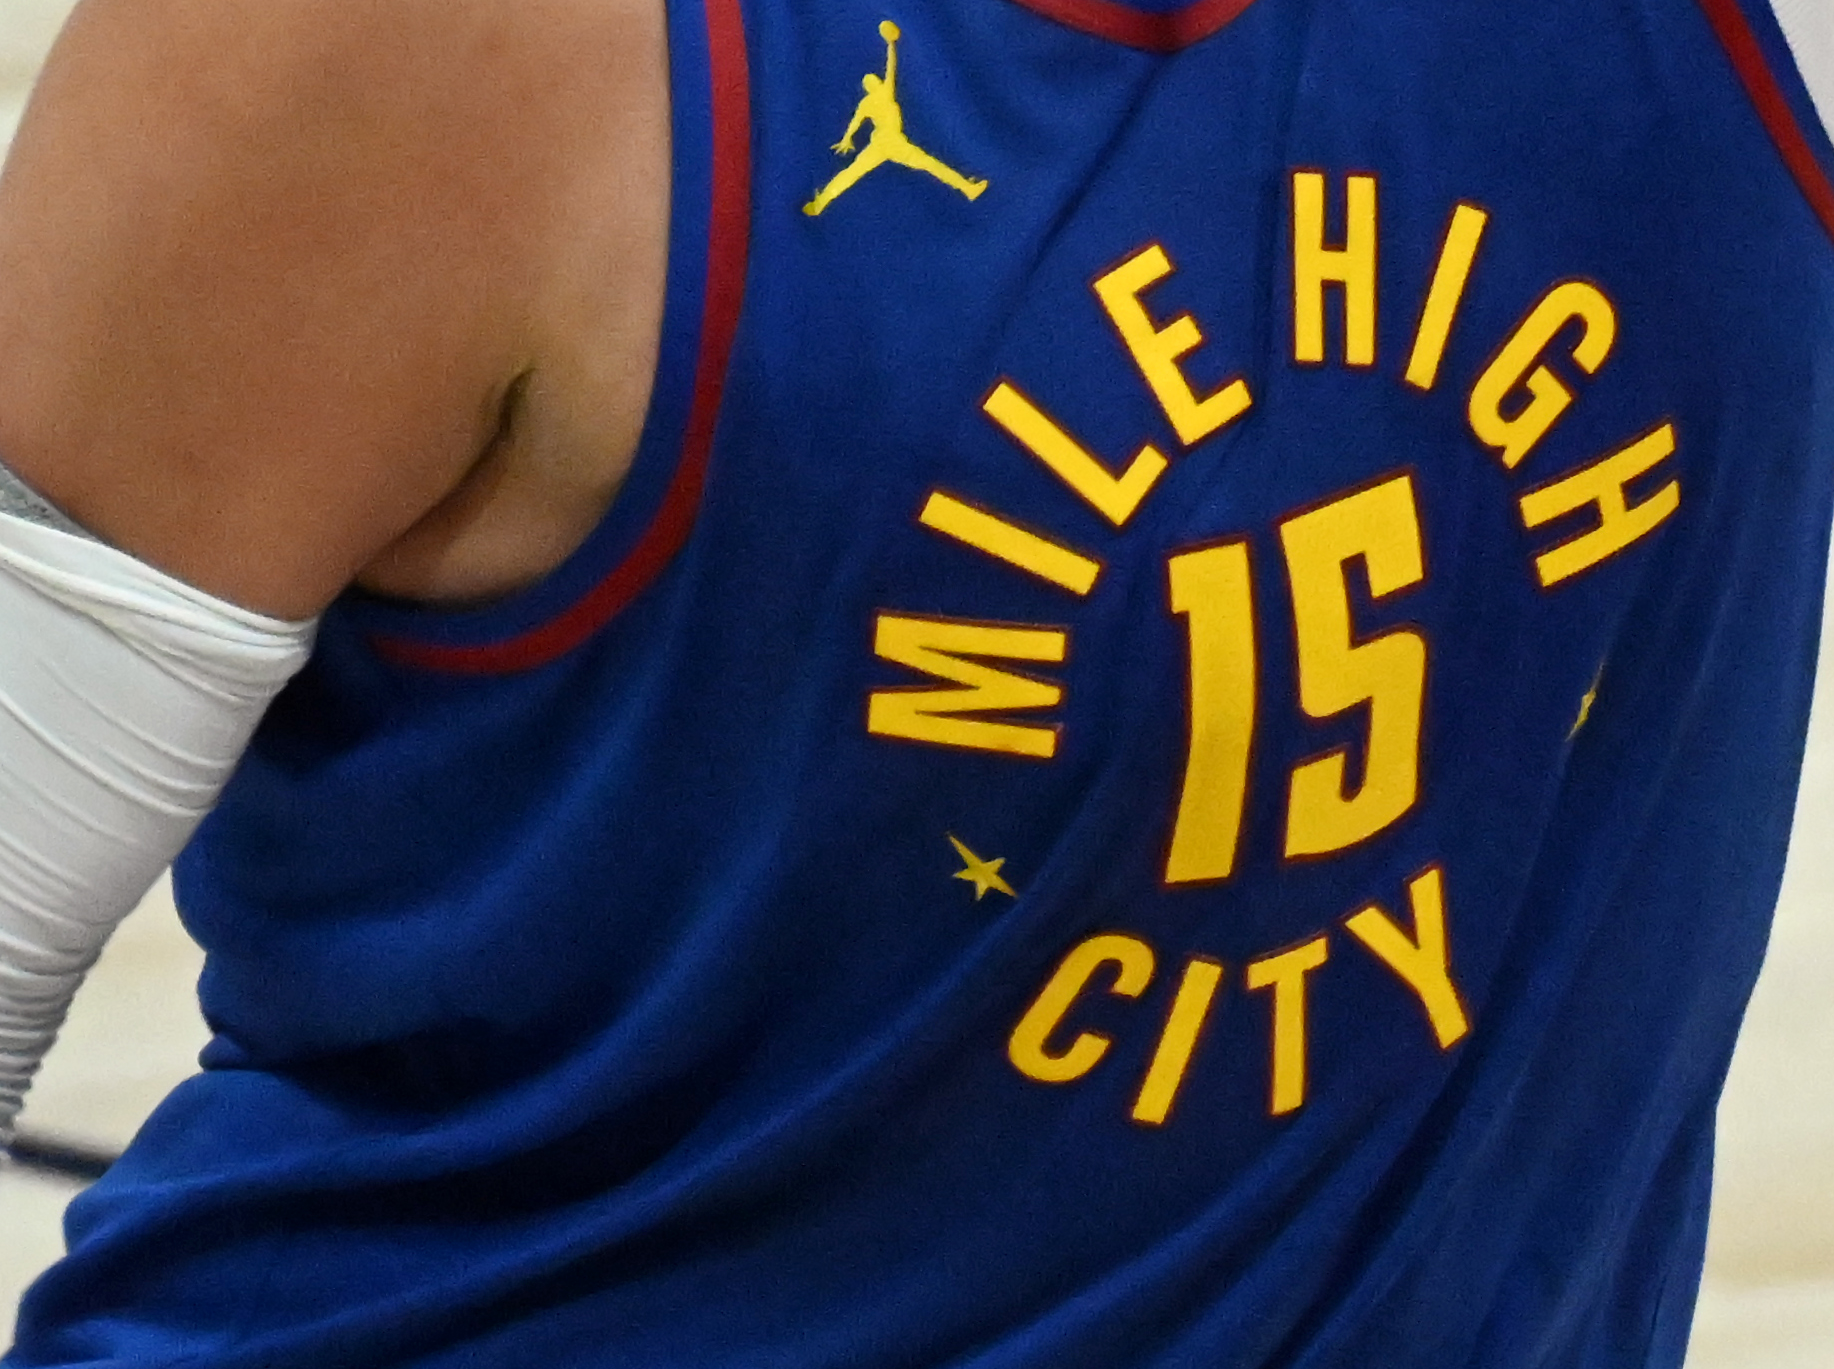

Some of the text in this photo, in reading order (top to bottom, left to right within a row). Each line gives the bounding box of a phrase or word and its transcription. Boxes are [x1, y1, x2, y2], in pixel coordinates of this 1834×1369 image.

[868, 171, 1682, 761] MILE HIGH
[1165, 475, 1427, 885] 15
[1007, 866, 1471, 1125] CITY
